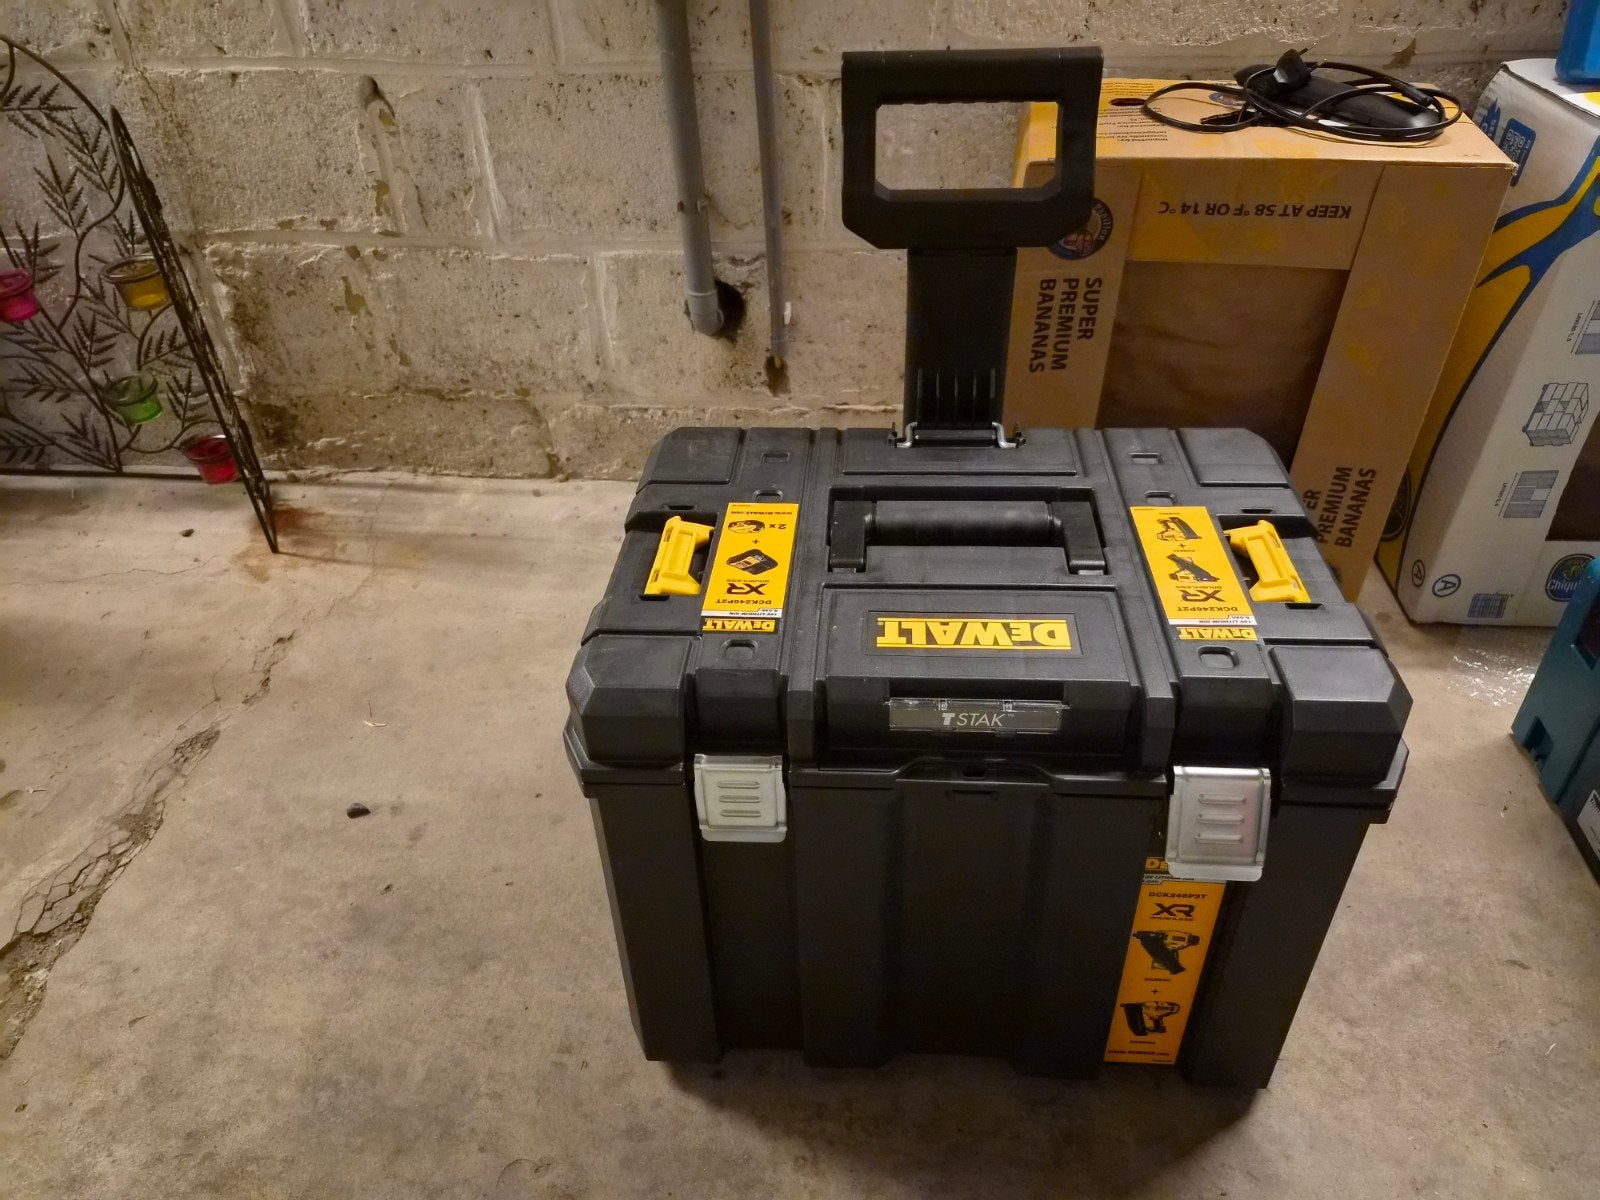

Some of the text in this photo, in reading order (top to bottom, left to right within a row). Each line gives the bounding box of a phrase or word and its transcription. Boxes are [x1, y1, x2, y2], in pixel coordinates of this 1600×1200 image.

[1181, 202, 1200, 215] 14
[1206, 202, 1231, 216] OR
[1255, 203, 1277, 217] 58
[1280, 204, 1304, 218] AT
[1307, 204, 1352, 219] KEEP
[1077, 277, 1103, 341] SUPER
[1028, 278, 1057, 373] BANANAS
[1051, 277, 1080, 371] PREMIUM
[1317, 466, 1353, 544] PREMIUM
[1334, 467, 1377, 547] BANANAS
[726, 583, 767, 595] XR
[1547, 580, 1583, 592] Chiqu
[1180, 589, 1226, 602] XR
[1151, 902, 1195, 918] XR
